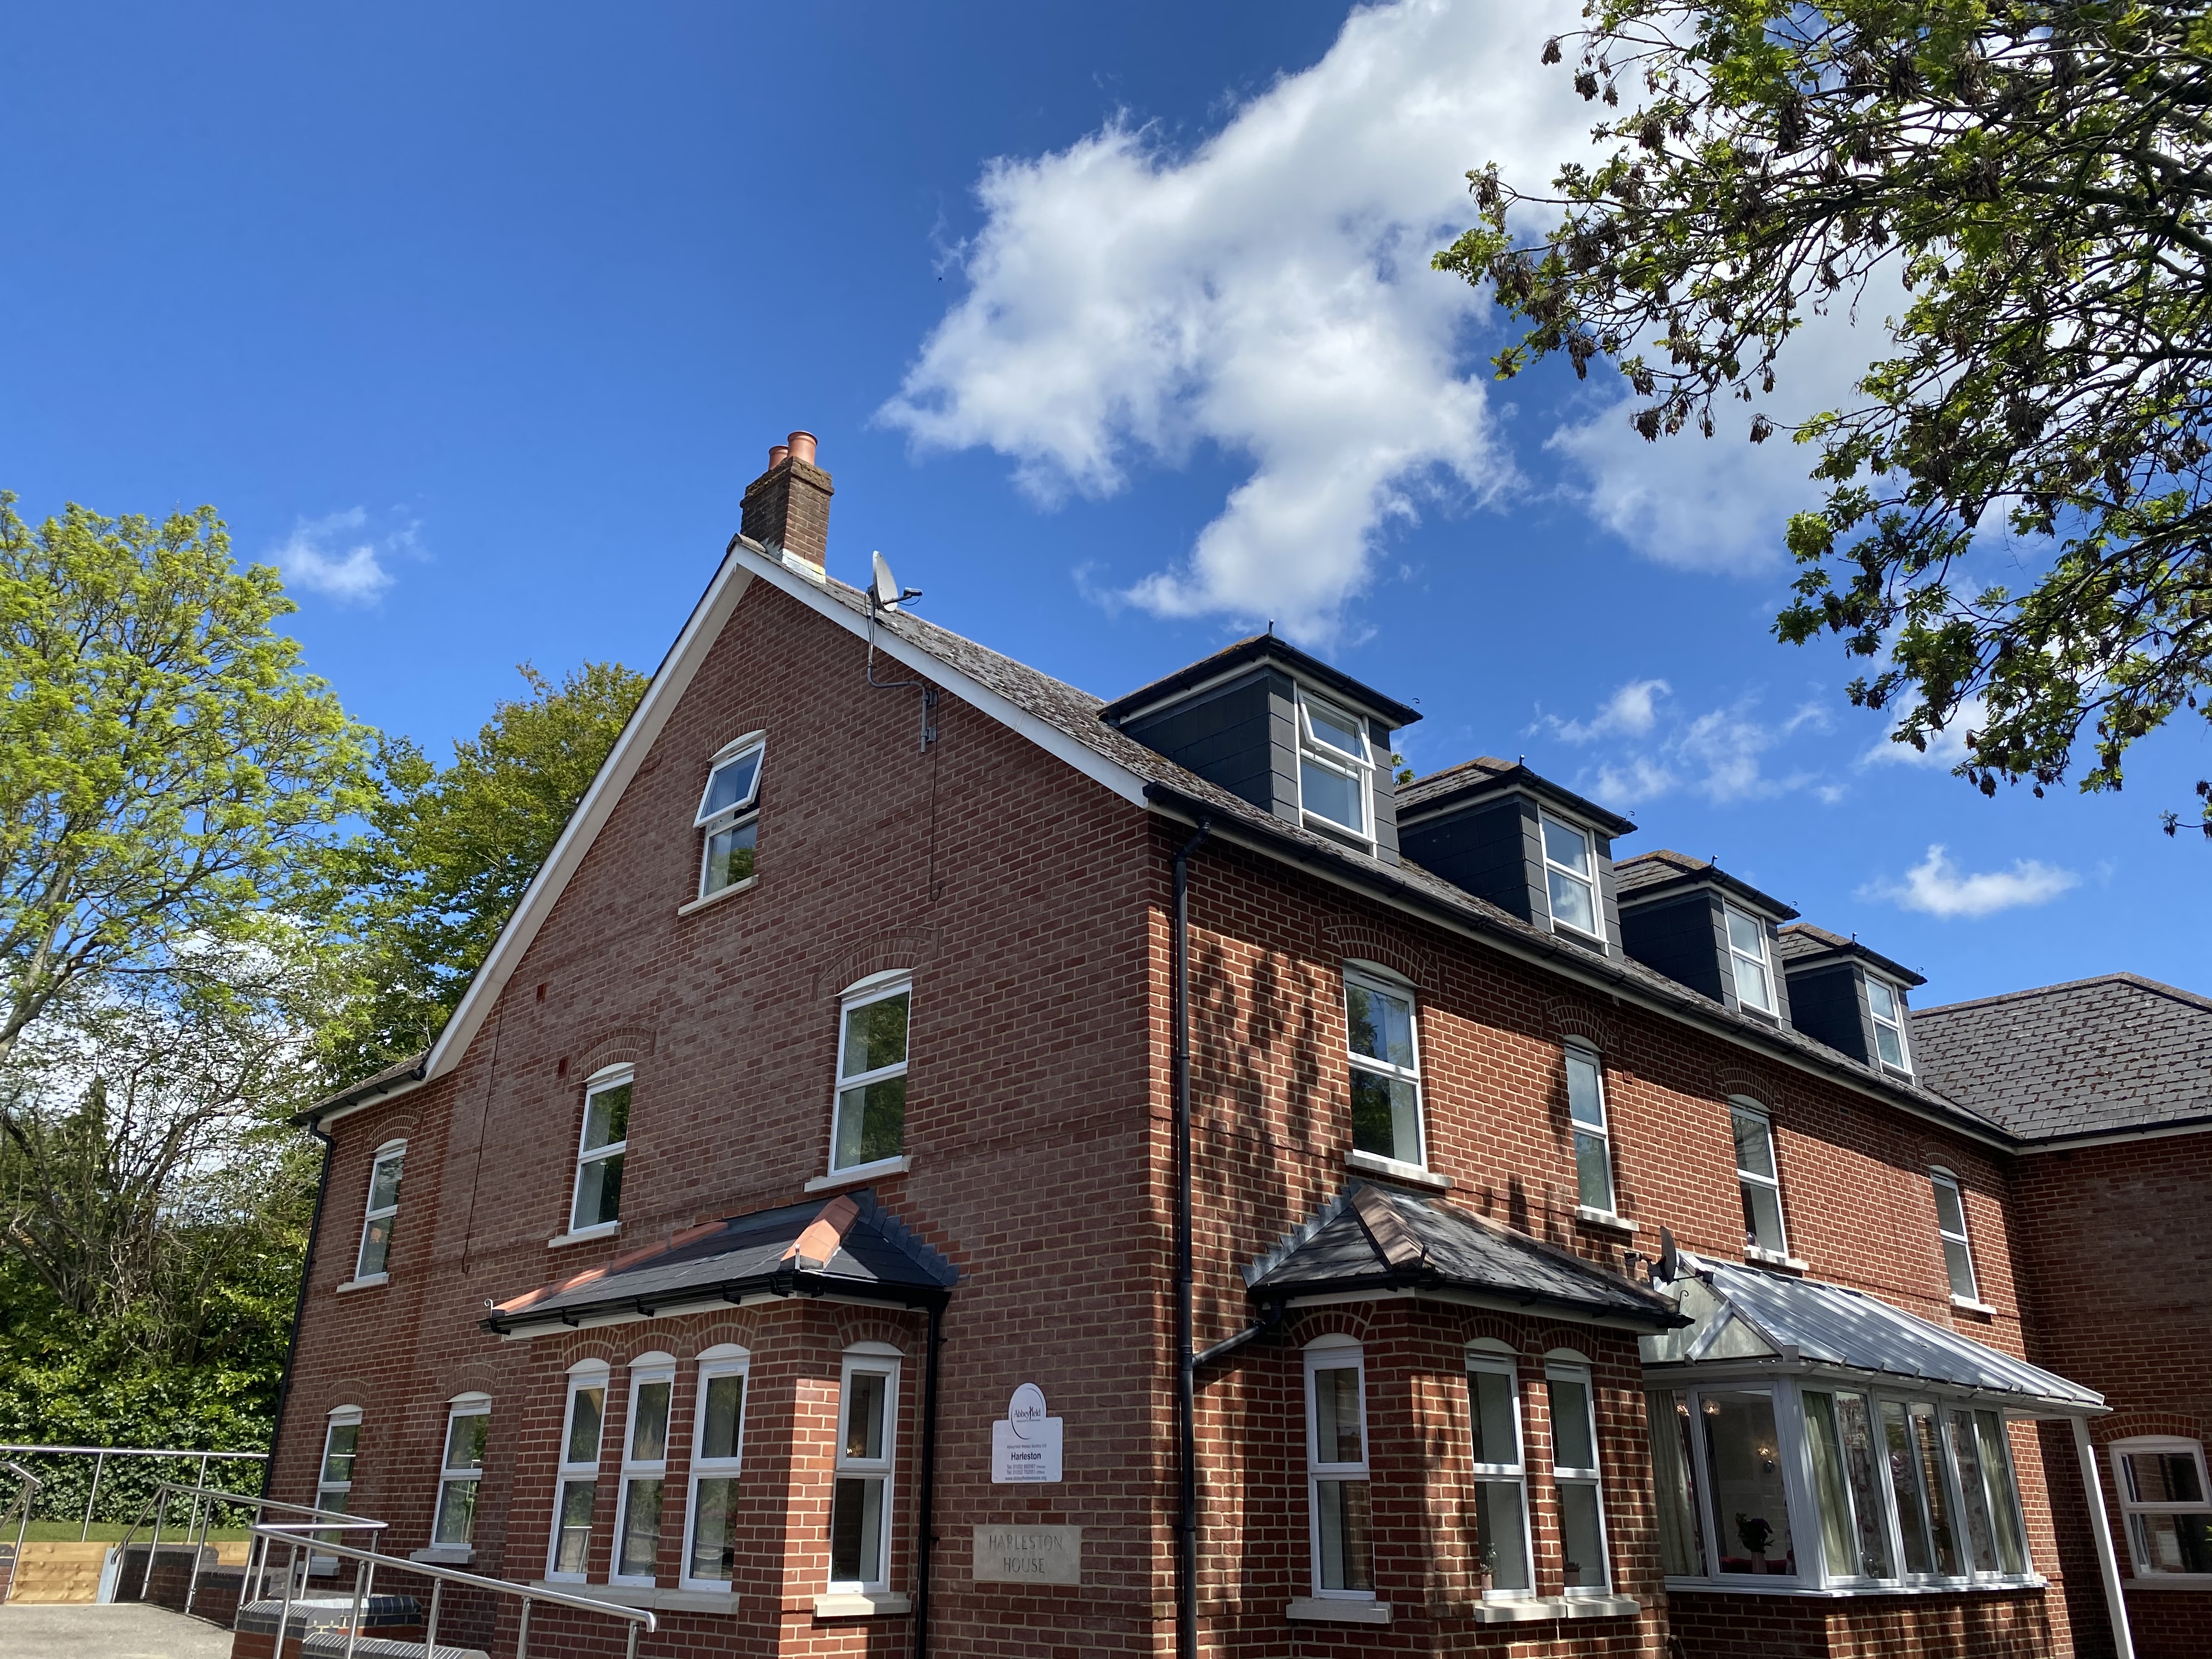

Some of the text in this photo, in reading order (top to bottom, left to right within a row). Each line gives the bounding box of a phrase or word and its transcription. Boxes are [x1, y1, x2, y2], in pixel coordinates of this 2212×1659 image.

[1014, 1406, 1041, 1420] Abbeyfield
[1011, 1452, 1041, 1460] Harleston
[989, 1534, 1062, 1550] HARLESTON
[1003, 1557, 1045, 1573] HOUSE
